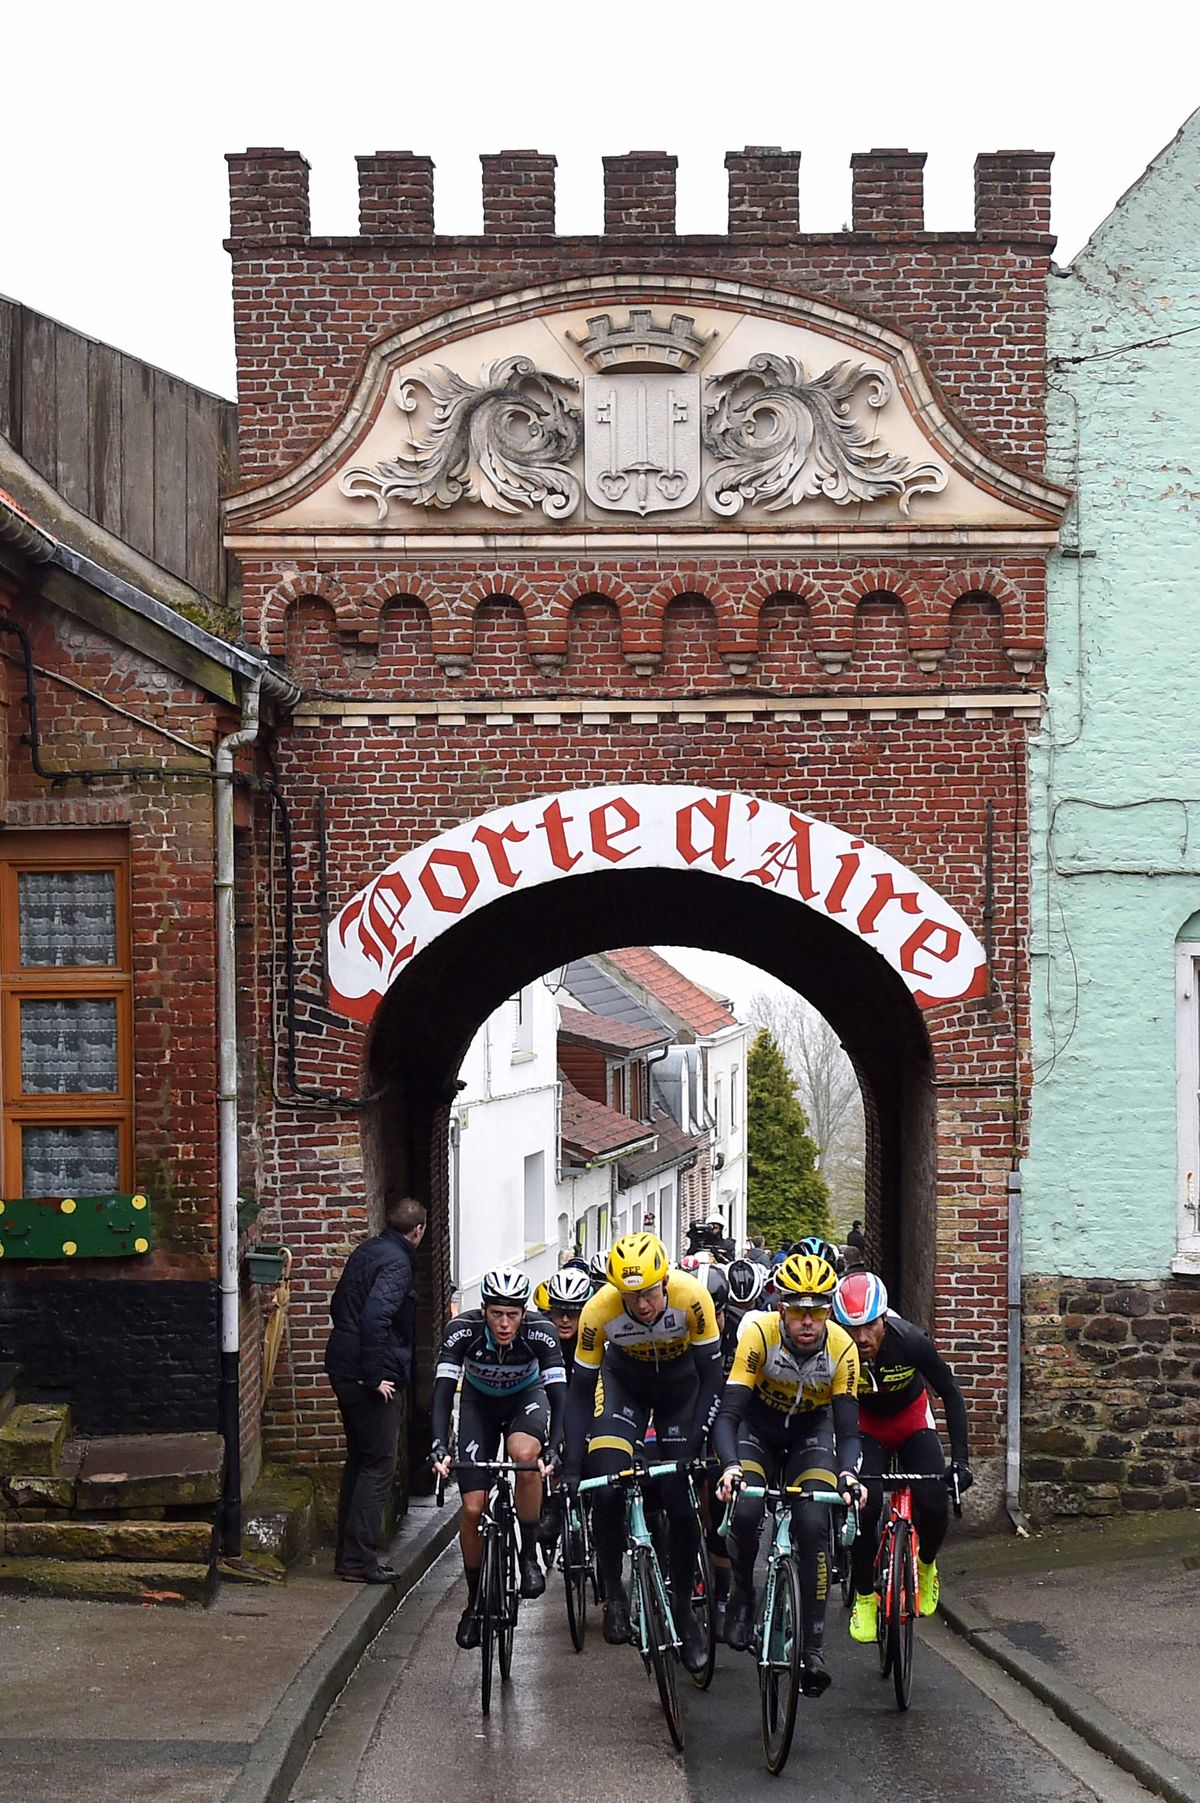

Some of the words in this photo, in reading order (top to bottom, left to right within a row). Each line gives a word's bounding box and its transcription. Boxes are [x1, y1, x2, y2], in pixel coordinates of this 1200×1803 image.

[338, 796, 641, 984] Porte
[675, 793, 962, 980] d'Aire
[527, 1328, 556, 1348] latexco
